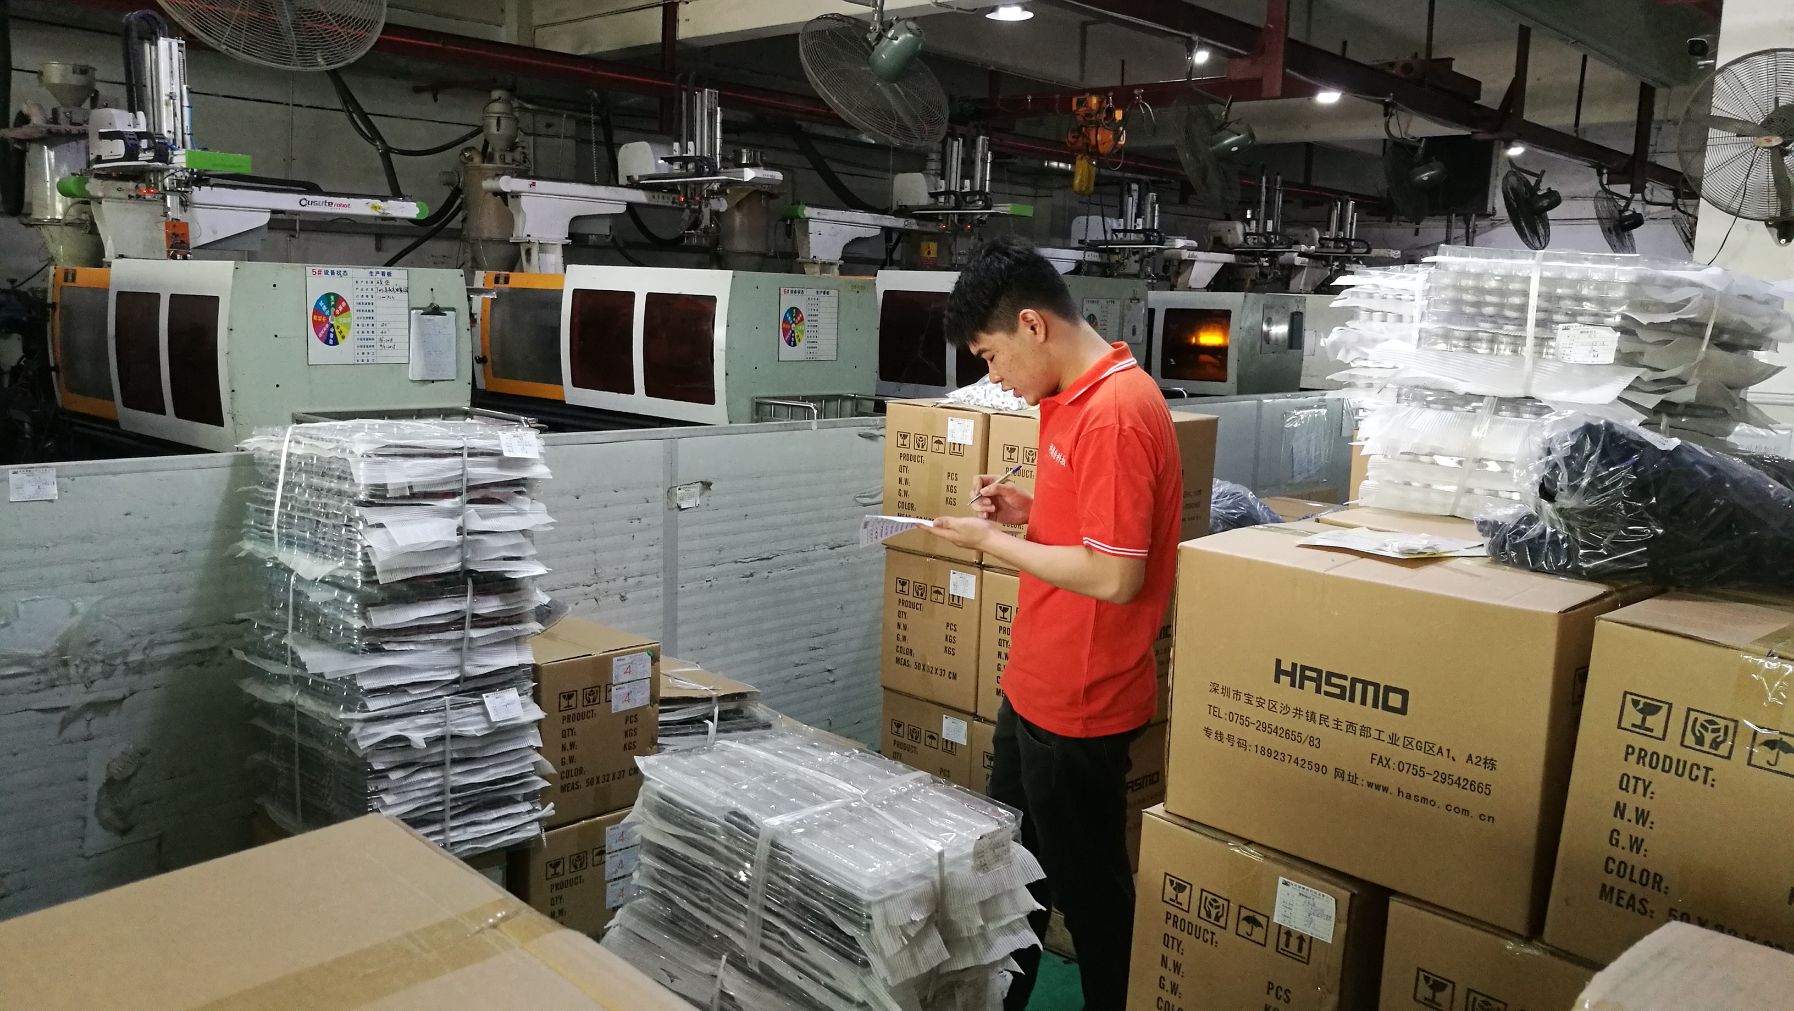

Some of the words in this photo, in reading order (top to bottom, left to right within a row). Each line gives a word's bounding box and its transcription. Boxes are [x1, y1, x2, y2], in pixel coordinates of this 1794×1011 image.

[899, 452, 925, 464] PRODUCT:
[947, 471, 959, 482] PCS
[946, 483, 958, 494] KGS
[897, 500, 917, 511] COLOR:
[945, 497, 957, 507] KGS
[945, 622, 958, 632] PCS
[943, 645, 956, 656] KGS
[944, 634, 957, 644] KGS
[948, 671, 958, 681] CM
[1273, 657, 1410, 716] HASMO
[562, 709, 597, 725] PRODUCT:
[625, 714, 638, 725] PCS
[1207, 703, 1322, 750] TEL:0755-29542655/83
[561, 727, 577, 739] QTY:
[624, 727, 638, 738] KGS
[623, 740, 637, 752] KGS
[1202, 726, 1329, 776] 专线号码:18923742590
[1370, 753, 1493, 797] FAX:0755-29542665
[1623, 743, 1716, 788] PRODUCT:
[560, 780, 582, 793] MEAS:
[1618, 772, 1655, 800] QTY:
[1613, 800, 1654, 830] N.W:
[1608, 828, 1648, 858] G.W:
[1603, 855, 1670, 895] COLOR:
[1598, 883, 1655, 919] MEAS:
[1165, 910, 1219, 948] PRODUCT:
[1162, 932, 1185, 956] QTY:
[1160, 954, 1185, 978] N.W:
[1158, 975, 1182, 998] G.W:
[1266, 980, 1292, 1004] PCS
